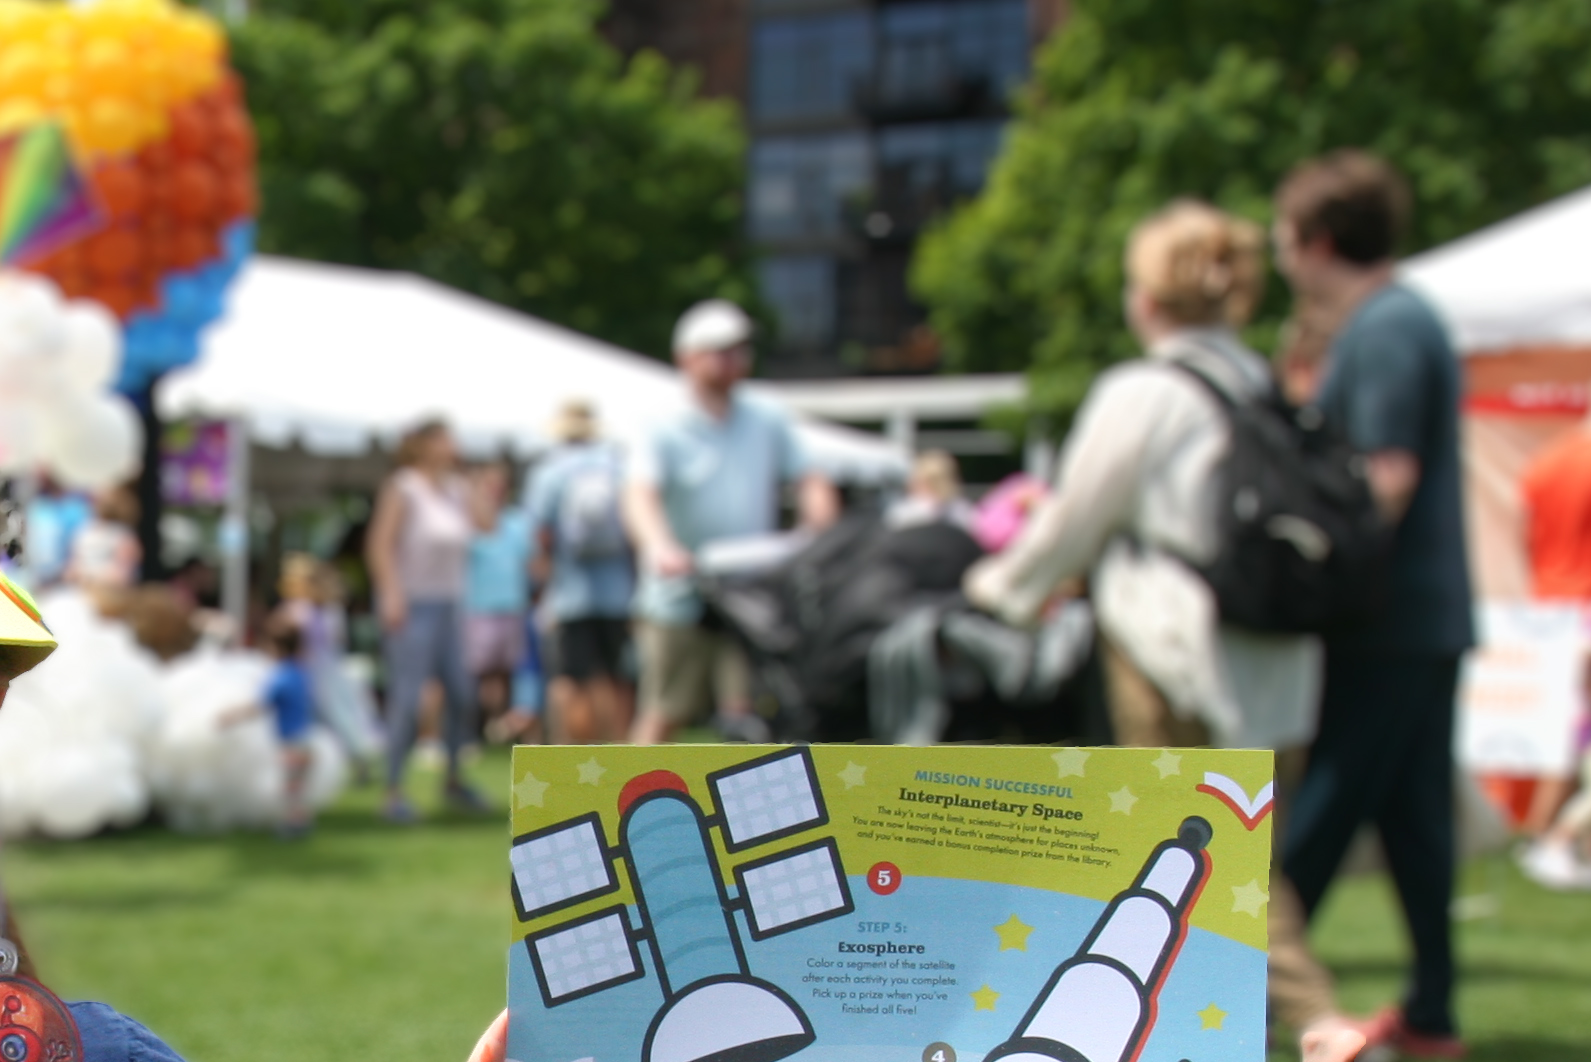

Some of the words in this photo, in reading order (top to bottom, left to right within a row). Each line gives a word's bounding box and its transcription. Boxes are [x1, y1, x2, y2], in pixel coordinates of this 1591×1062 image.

[914, 770, 981, 788] MISSION
[985, 778, 1073, 799] SUCCESSFUL
[899, 787, 1028, 817] Interplanetary
[1032, 803, 1083, 821] Space
[877, 870, 891, 886] 5
[858, 922, 890, 933] STEP
[894, 922, 907, 933] 5:
[838, 941, 925, 957] Exosphere
[807, 958, 834, 969] Color
[847, 960, 887, 971] segment
[889, 959, 899, 969] of
[901, 960, 916, 970] the
[919, 960, 955, 970] satellite
[802, 973, 824, 983] after
[827, 974, 850, 984] each
[853, 974, 887, 986] activity
[890, 977, 908, 986] you
[911, 976, 958, 988] complete.
[812, 988, 830, 998] Pick
[834, 991, 847, 1001] up
[859, 989, 883, 1001] prize
[886, 989, 913, 1000] when
[915, 990, 948, 1002] you've
[842, 1003, 878, 1014] finished
[881, 1004, 894, 1015] all
[896, 1004, 917, 1015] five!
